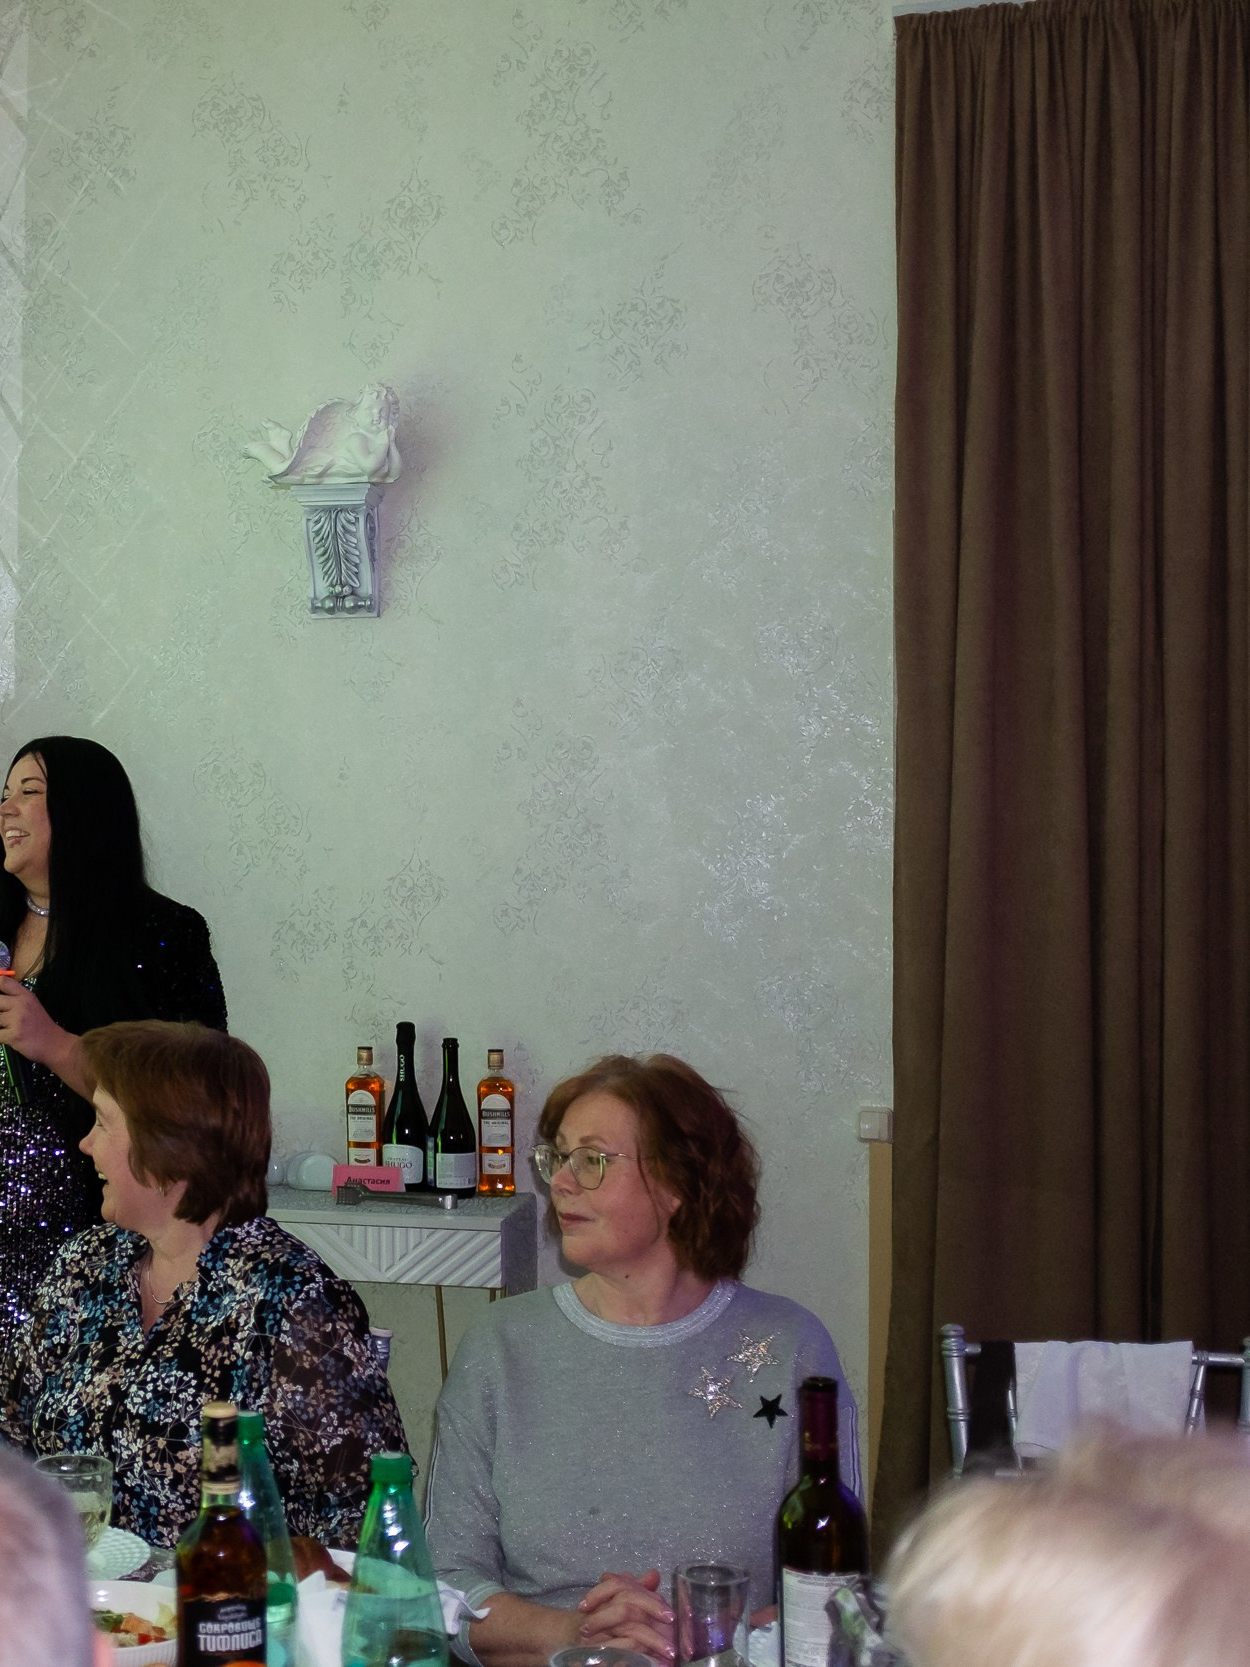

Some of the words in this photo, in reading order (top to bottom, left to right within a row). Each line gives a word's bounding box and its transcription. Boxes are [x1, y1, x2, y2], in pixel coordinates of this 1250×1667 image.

[348, 1105, 376, 1113] BUSHMILLS
[482, 1110, 511, 1118] BUSHMILLS
[346, 1176, 391, 1185] Анастасия
